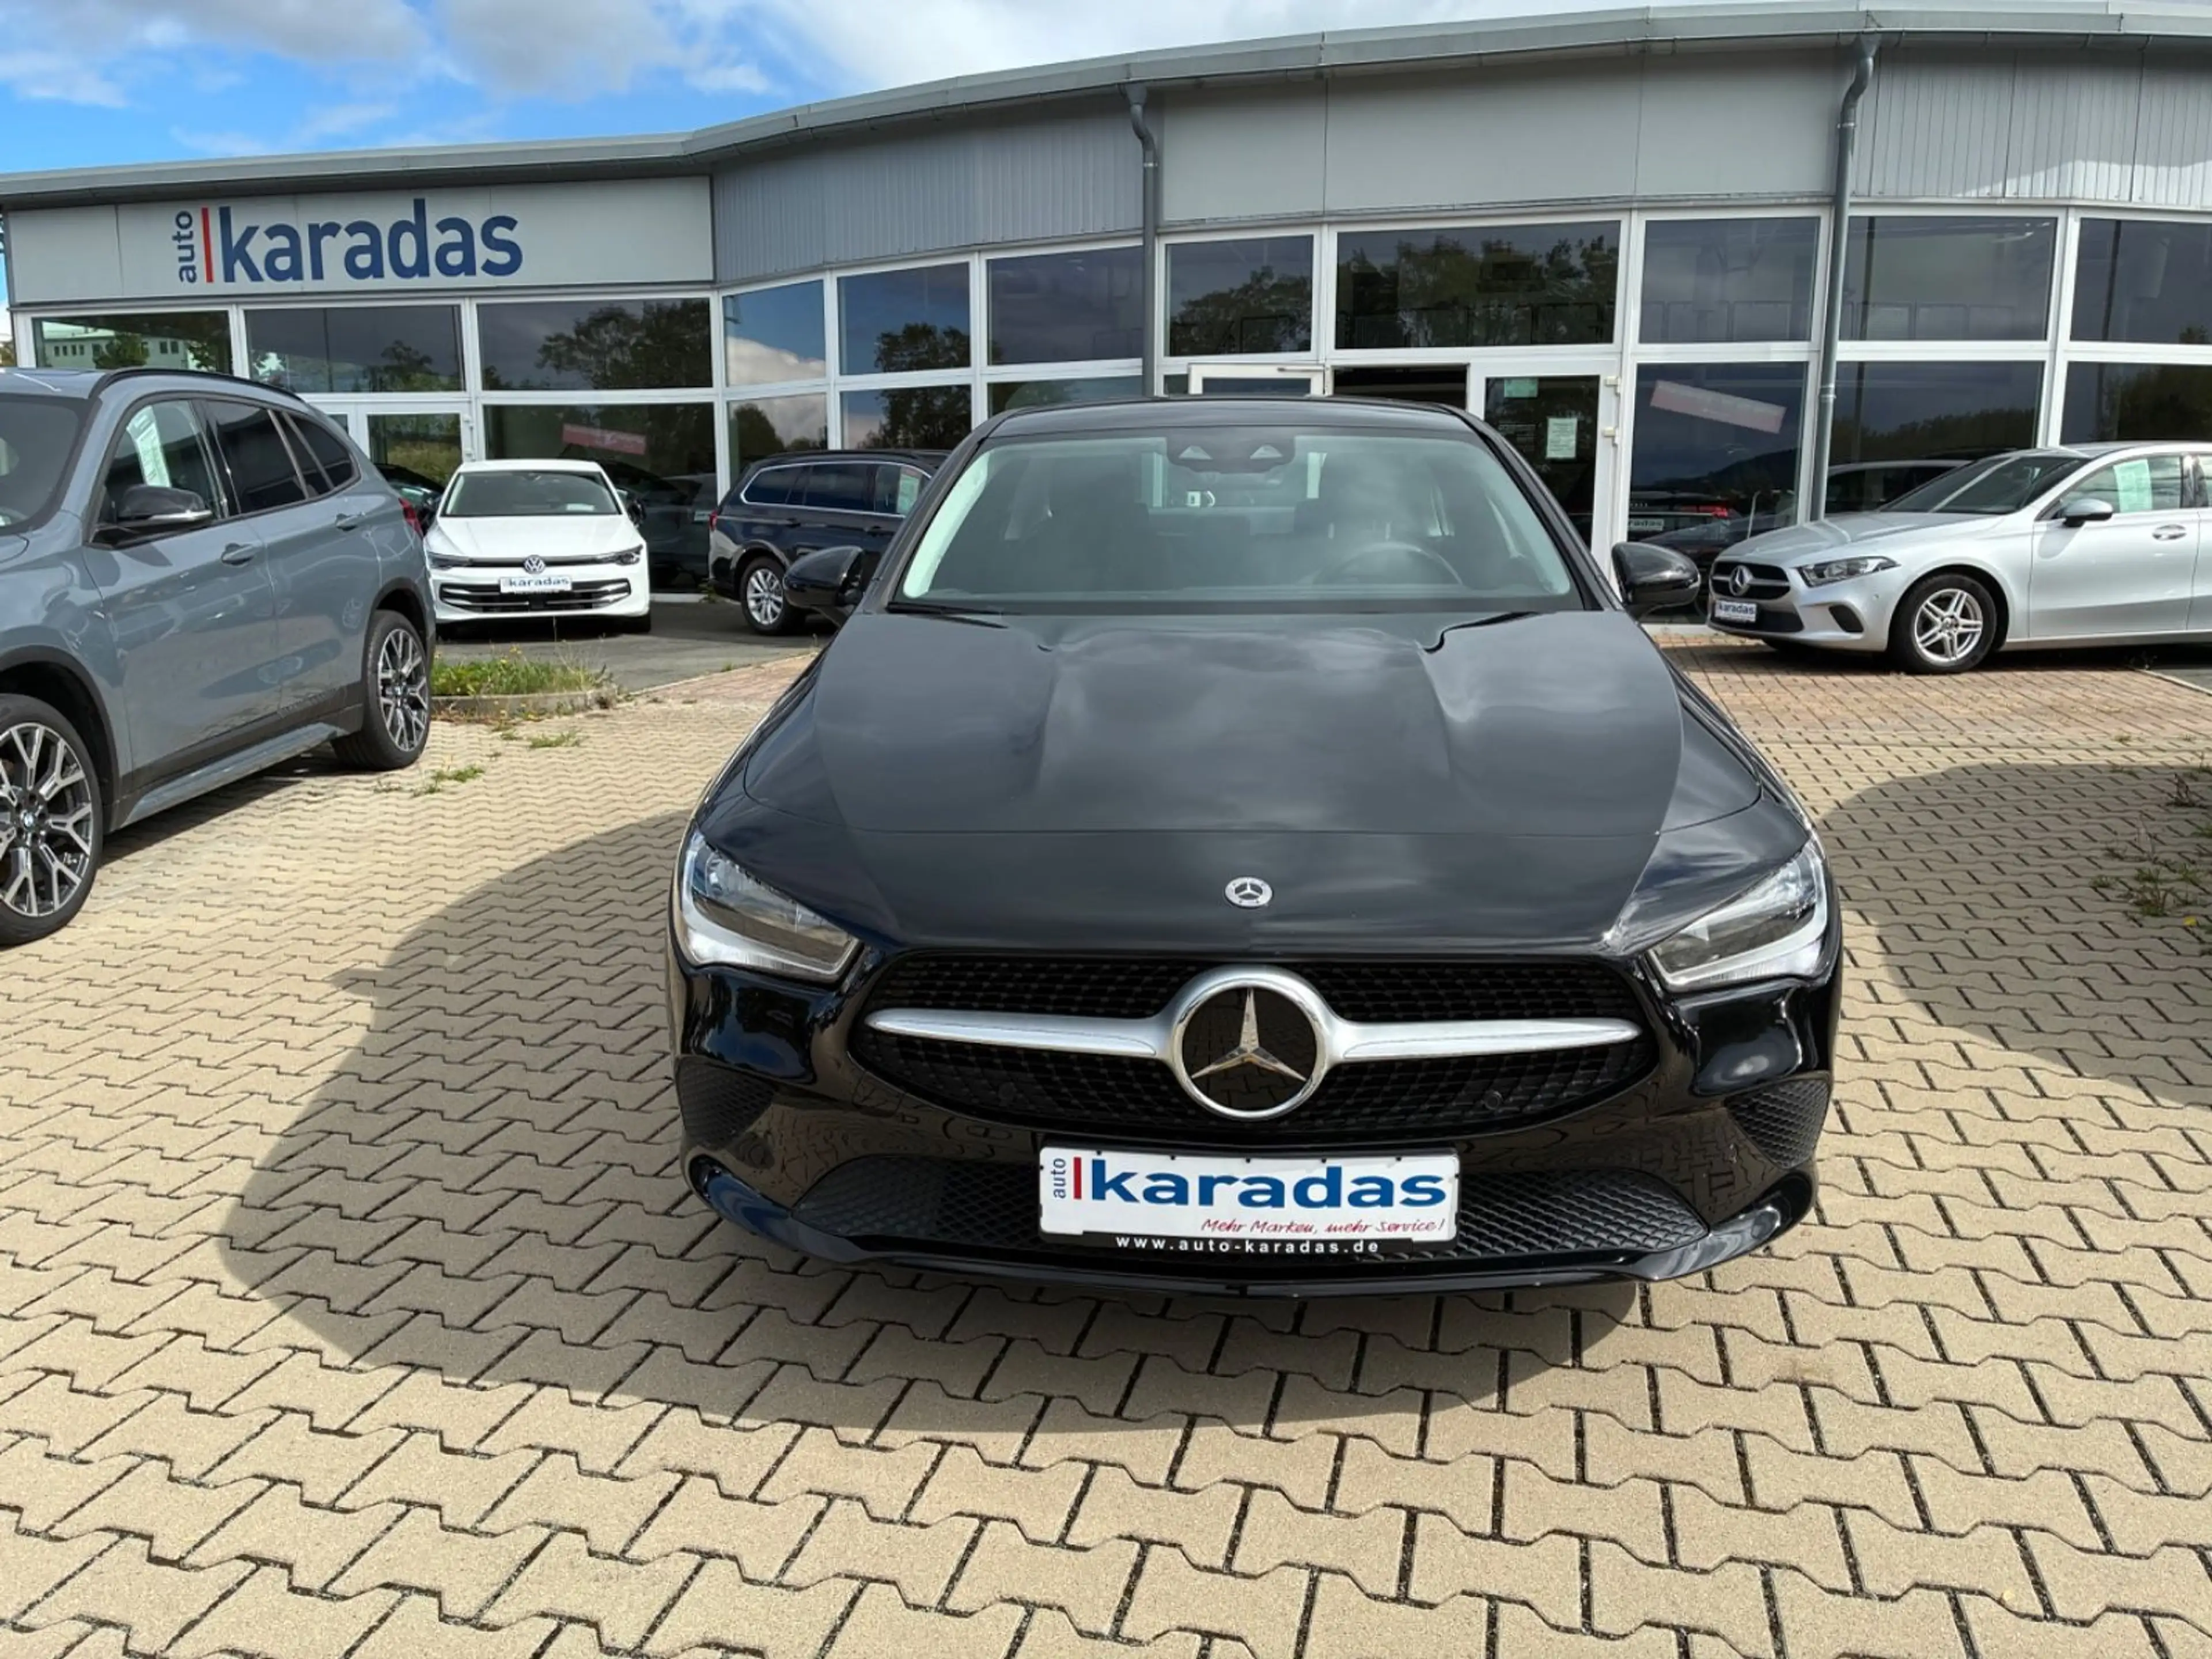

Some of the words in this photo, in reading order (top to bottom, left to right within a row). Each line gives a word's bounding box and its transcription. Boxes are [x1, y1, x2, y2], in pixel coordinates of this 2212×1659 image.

[172, 210, 197, 284] auto
[218, 198, 523, 283] karadas
[509, 577, 569, 587] karadas
[1050, 1158, 1066, 1199] auto
[1092, 1158, 1446, 1208] karadas
[1116, 1237, 1378, 1253] www.auto-karadas.de
[1201, 1218, 1247, 1232] Mehr
[1325, 1219, 1372, 1233] mehr
